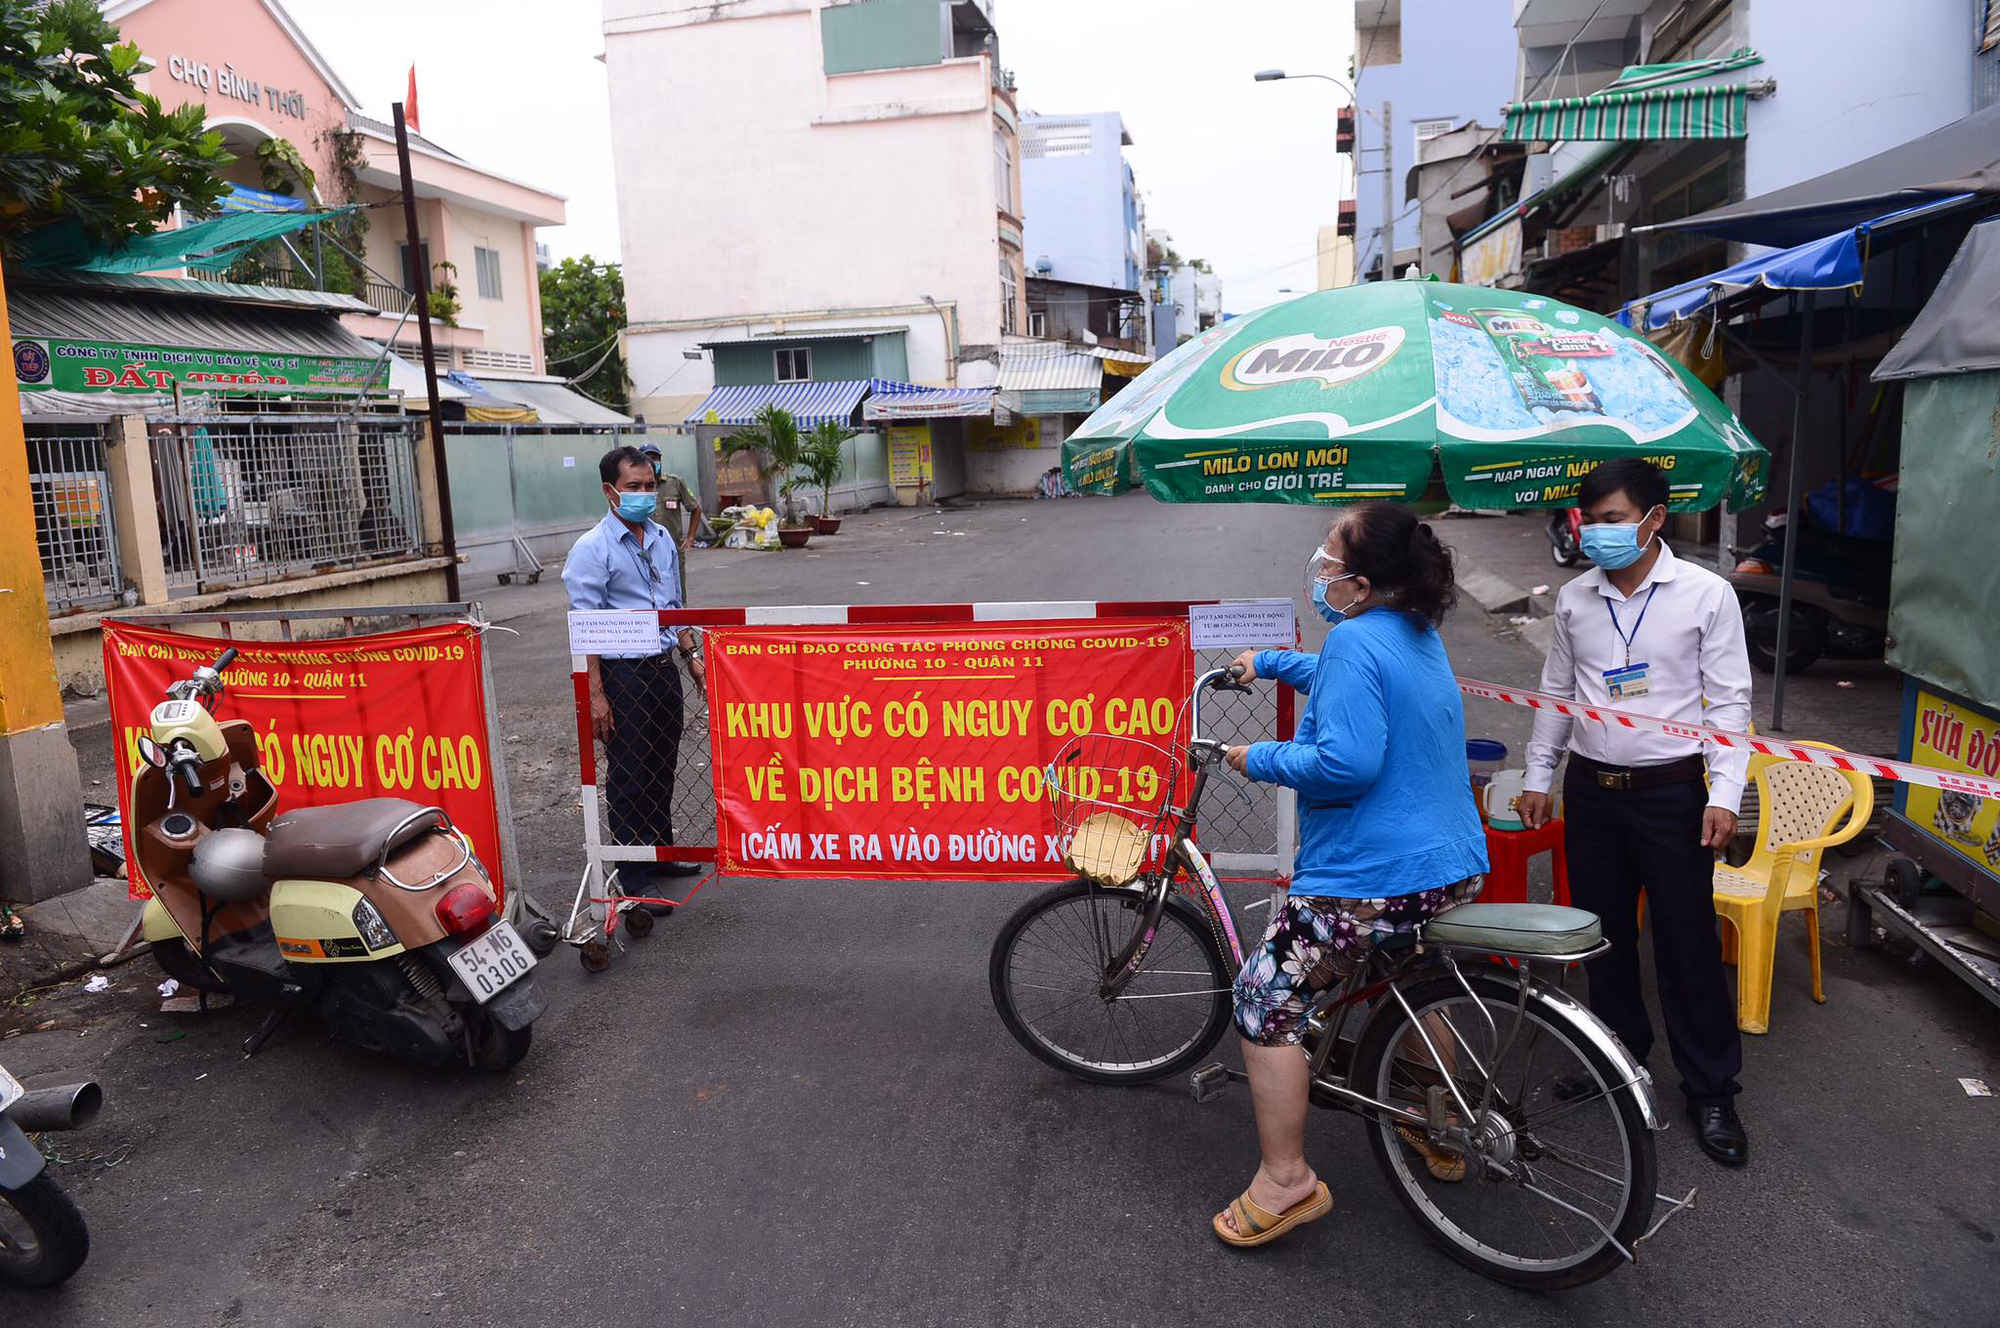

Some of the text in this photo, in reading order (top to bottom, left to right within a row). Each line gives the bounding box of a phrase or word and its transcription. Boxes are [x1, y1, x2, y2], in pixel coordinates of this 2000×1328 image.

[167, 54, 211, 94] CHỢ
[215, 62, 260, 107] BÌNH
[1328, 331, 1389, 348] Nestlé
[1539, 336, 1591, 347] Protein
[1553, 342, 1590, 351] Canxi
[56, 344, 97, 359] CÔNG
[100, 348, 117, 359] TY
[123, 349, 159, 361] TNHH
[163, 351, 192, 365] DỊCH
[197, 354, 212, 366] VỤ
[1245, 342, 1385, 374] MILO
[83, 362, 173, 389] ĐẤT
[1203, 444, 1349, 476] MILO LON MỚI
[1238, 480, 1262, 491] CHO
[1264, 470, 1304, 491] GIỚI
[1307, 467, 1344, 489] TRẺ
[1494, 469, 1523, 483] NẠP
[1526, 464, 1563, 479] NGAY
[1515, 489, 1539, 503] VỚI
[118, 642, 146, 657] BAN
[176, 648, 206, 662] ĐẠO
[245, 650, 277, 664] TÁC
[333, 646, 391, 663] CHỐNG
[393, 645, 465, 662] COVID-19
[726, 643, 762, 655] BAN
[803, 643, 841, 656] ĐẠO
[845, 640, 894, 653] CÔNG
[902, 638, 936, 652] TÁC
[942, 637, 1006, 652] PHÒNG
[1011, 635, 1076, 650] CHỐNG
[1081, 636, 1170, 650] COVID-19
[843, 656, 917, 671] PHƯỜNG
[923, 658, 946, 669] 10
[964, 656, 1015, 670] QUẬN
[1022, 657, 1044, 668] 11
[219, 667, 268, 687] HƯỜNG
[273, 672, 291, 687] 10
[303, 668, 344, 690] QUẬN
[349, 672, 367, 688] 11
[726, 691, 1175, 745] KHU VỰC CÓ NGUY CƠ CAO
[292, 733, 363, 788] NGUY
[376, 726, 415, 790] CƠ
[421, 734, 482, 790] CAO
[744, 752, 1159, 812] VỀ DỊCH BỆNH COVID-19
[809, 833, 841, 860] XE
[849, 833, 883, 861] RA
[889, 827, 940, 861] VÀO
[948, 827, 1036, 862] ĐƯỜNG
[460, 928, 513, 973] 54-M6
[476, 949, 528, 994] 0306
